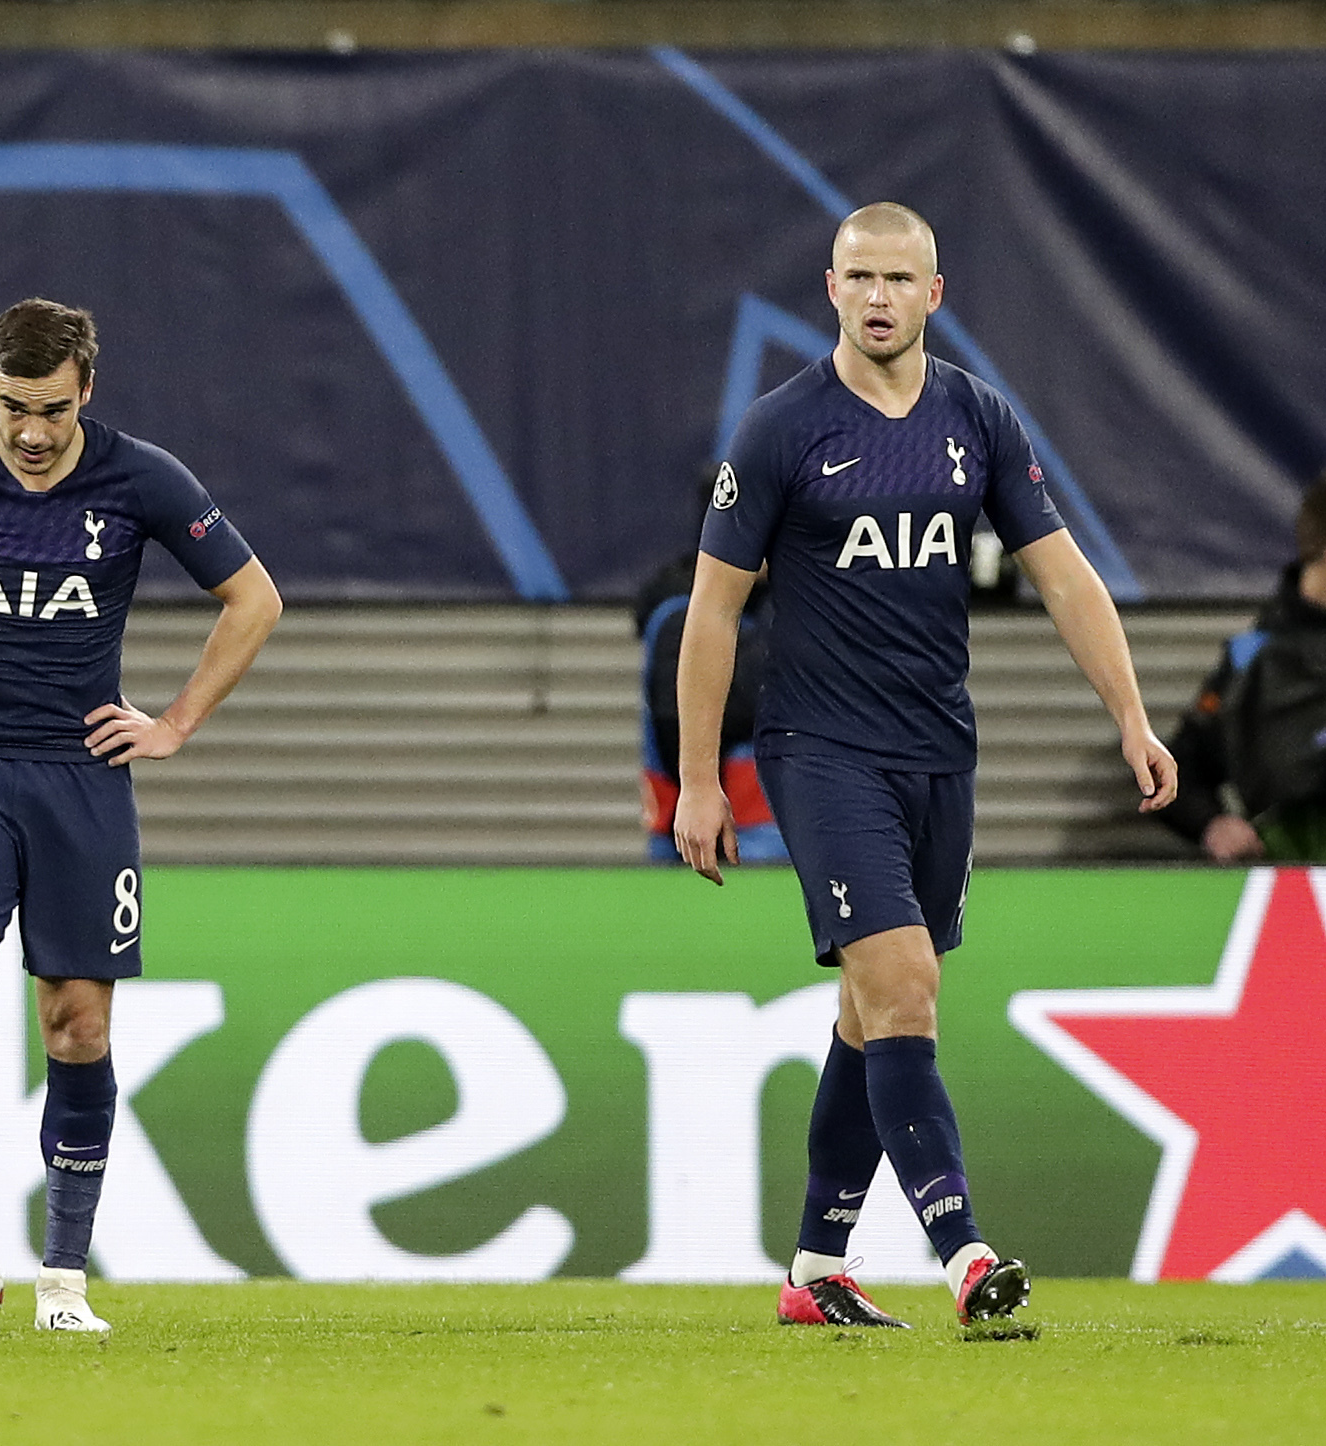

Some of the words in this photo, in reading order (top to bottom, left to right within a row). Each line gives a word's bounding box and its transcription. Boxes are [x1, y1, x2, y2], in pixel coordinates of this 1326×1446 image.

[835, 511, 958, 570] AIA
[112, 867, 141, 935] 8
[52, 1154, 106, 1172] SPURS
[922, 1195, 963, 1227] SPURS
